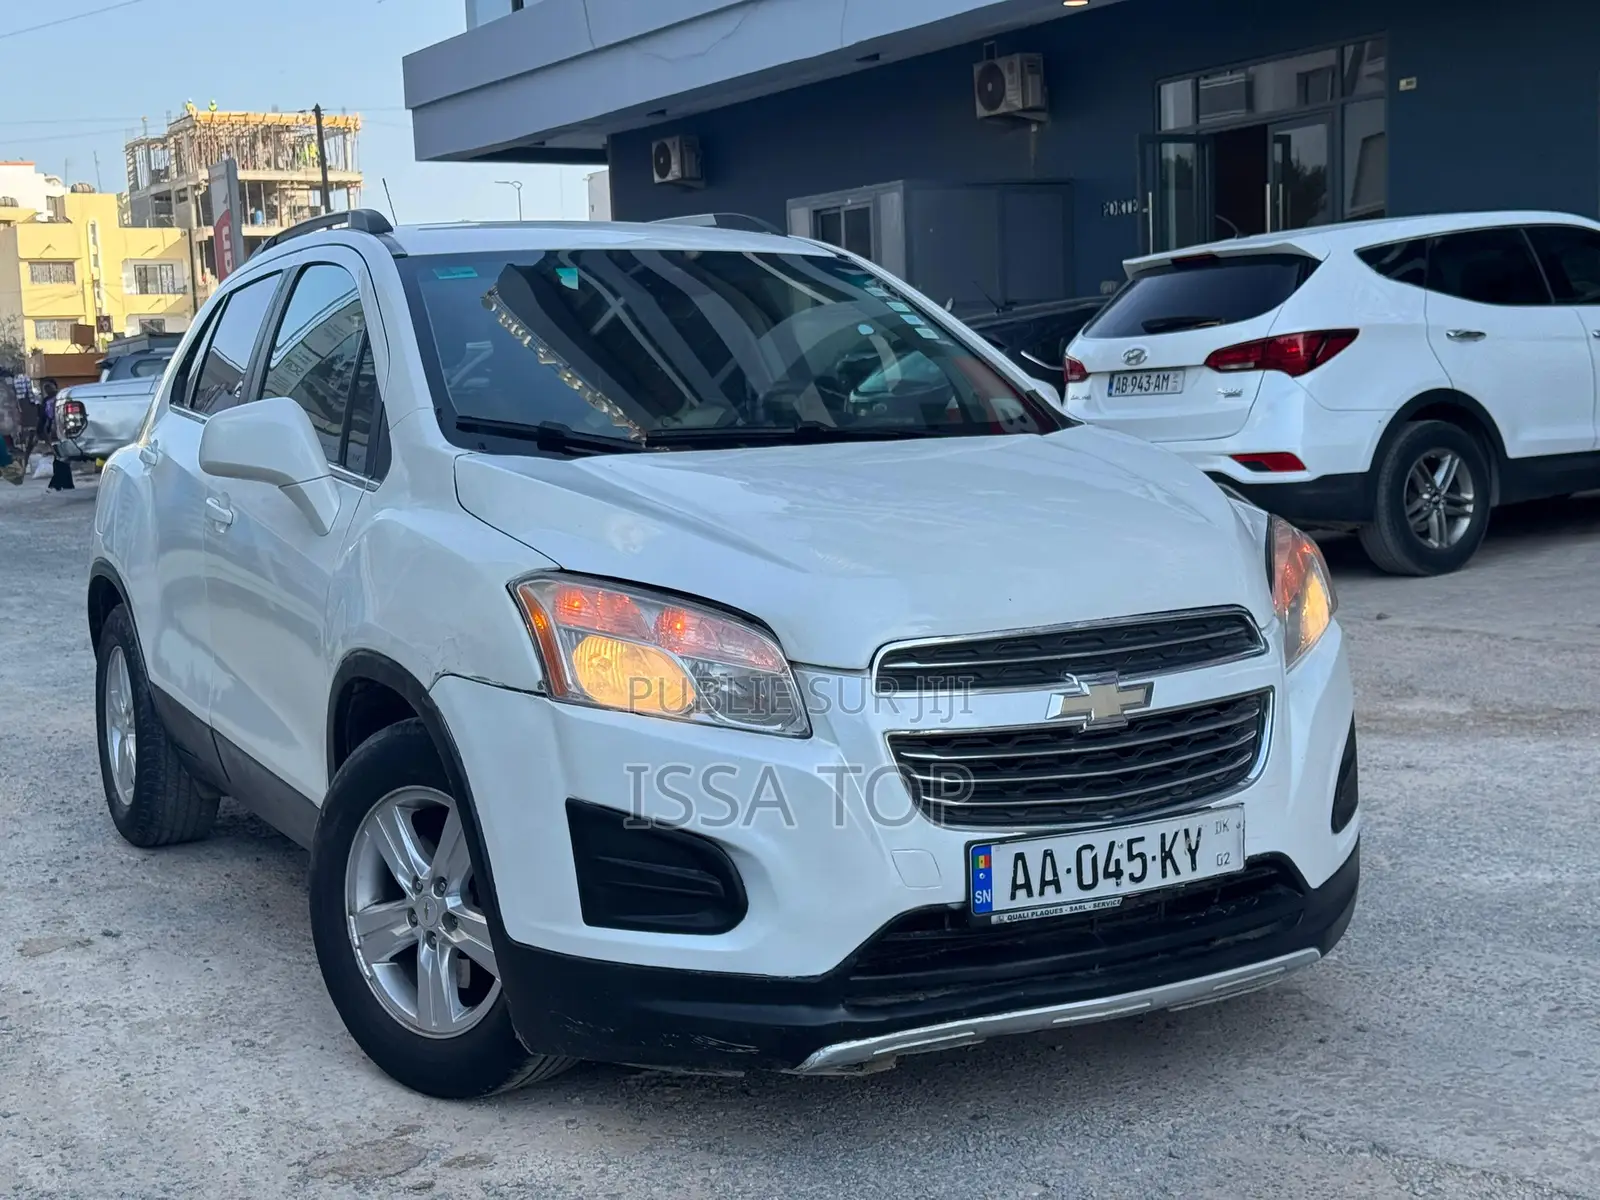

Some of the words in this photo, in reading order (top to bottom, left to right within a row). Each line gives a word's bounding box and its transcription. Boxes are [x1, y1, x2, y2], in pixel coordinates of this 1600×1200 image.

[974, 888, 992, 904] SN
[1007, 913, 1029, 921] QUALI
[1031, 908, 1063, 917] PLAQUES
